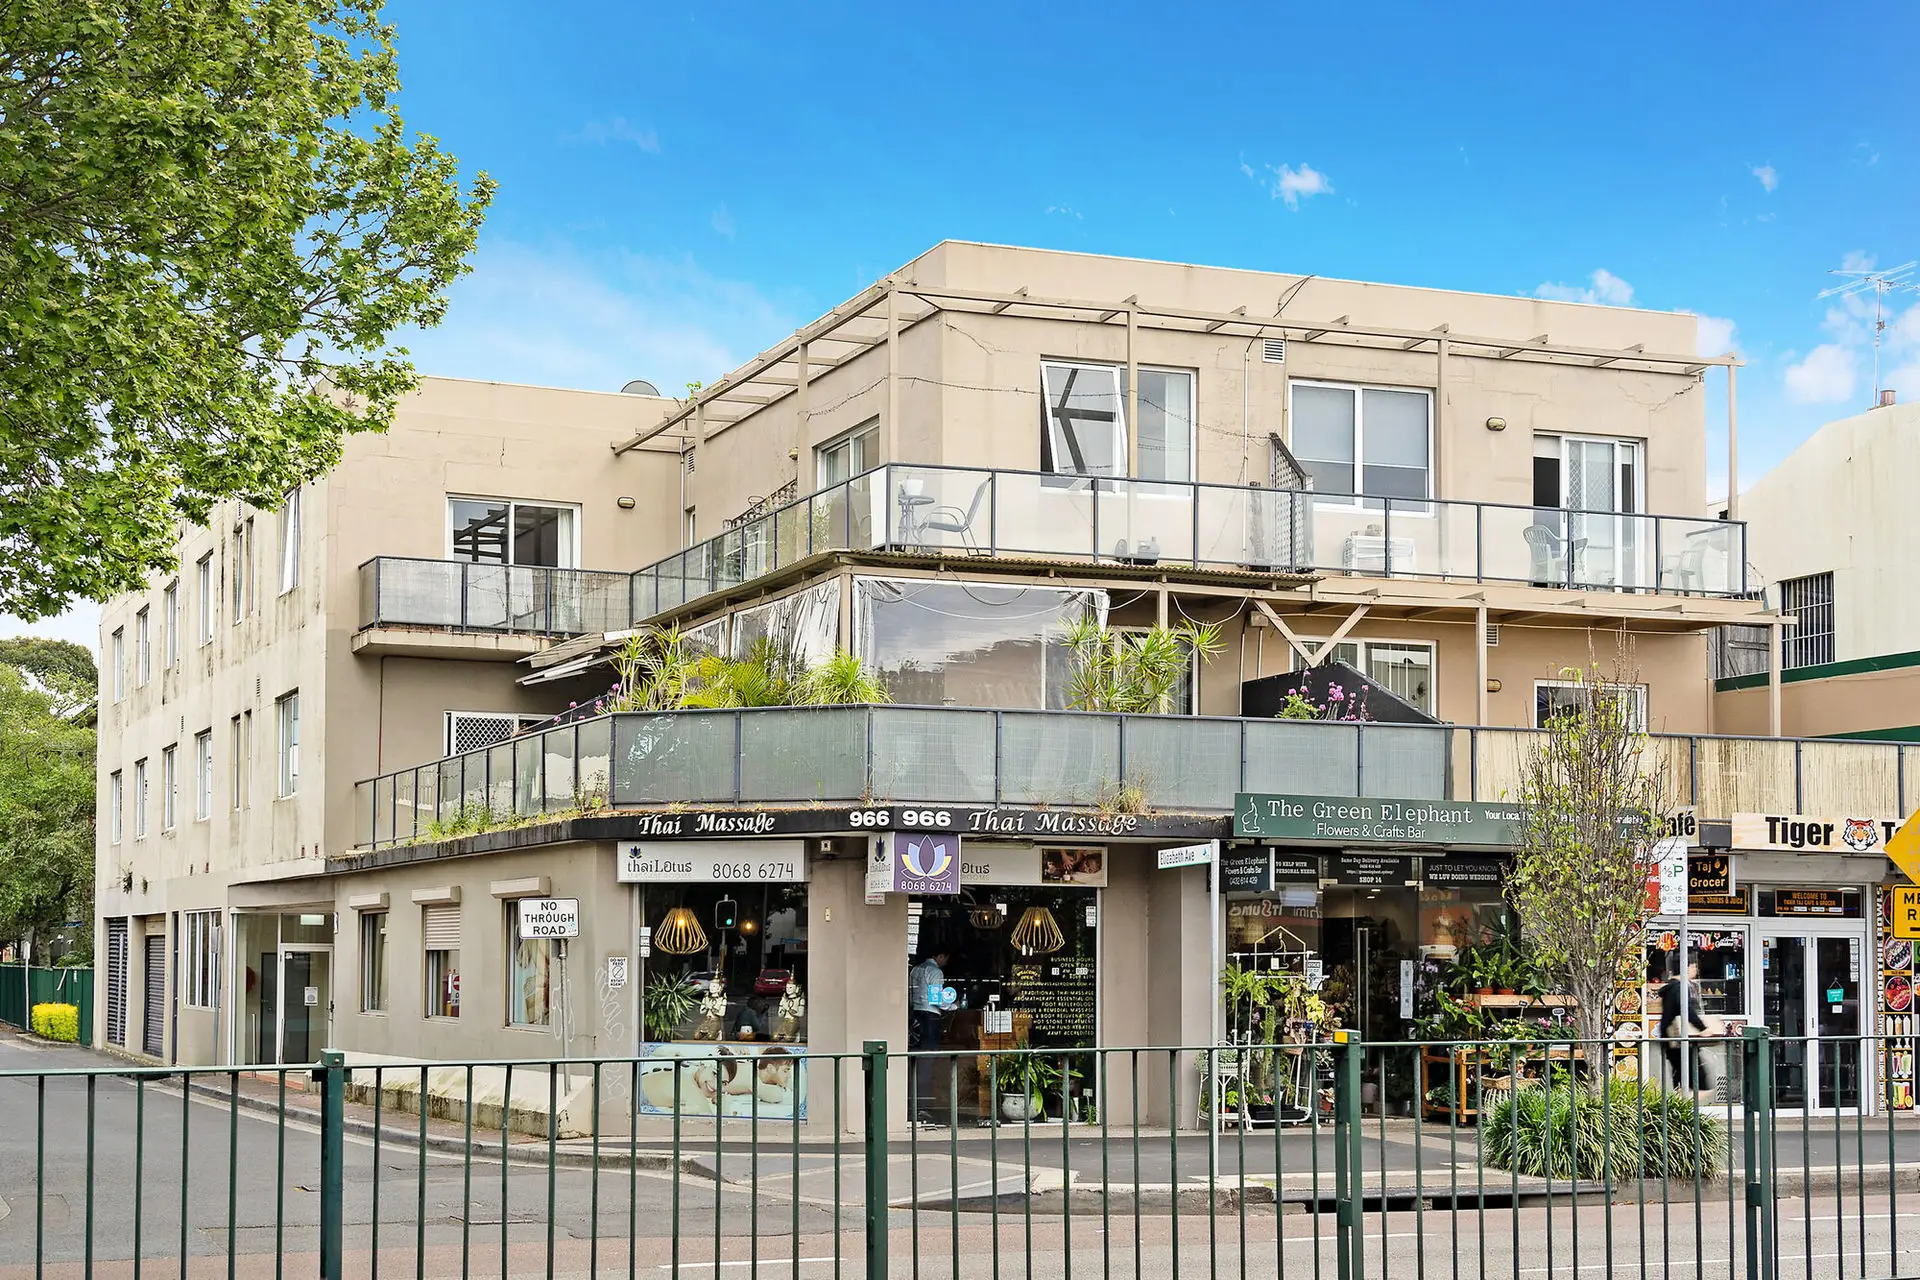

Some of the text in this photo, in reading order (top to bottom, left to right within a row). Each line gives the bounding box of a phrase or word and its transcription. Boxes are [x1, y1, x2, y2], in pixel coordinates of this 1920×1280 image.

[1267, 799, 1473, 825] The Green Elephant
[1484, 810, 1501, 820] Your
[1502, 811, 1521, 821] Loca
[638, 812, 776, 835] Thai Massage
[849, 810, 890, 827] 966
[902, 810, 951, 827] 966
[967, 808, 1137, 836] Thai Massage
[1317, 824, 1426, 839] Flowers & Crafts Bar
[1765, 817, 1834, 848] Tiger
[1160, 848, 1195, 866] Elizabeth Ave
[1230, 858, 1244, 866] Green
[1245, 856, 1268, 866] Elephant
[712, 862, 794, 879] 8068 6274
[1224, 867, 1240, 875] Flowers
[1243, 866, 1255, 875] Crafts
[1255, 865, 1263, 874] Bar
[1429, 864, 1443, 872] JUST
[1696, 861, 1711, 873] Taj
[900, 881, 926, 892] 8068
[929, 881, 952, 893] 6274
[1690, 877, 1725, 888] Grocer
[1820, 892, 1828, 900] TO
[541, 901, 557, 911] NO
[524, 913, 574, 923] THROUGH
[1908, 909, 1920, 920] R
[533, 926, 566, 935] ROAD
[1875, 886, 1884, 1011] SMOOTHIE BOWLS
